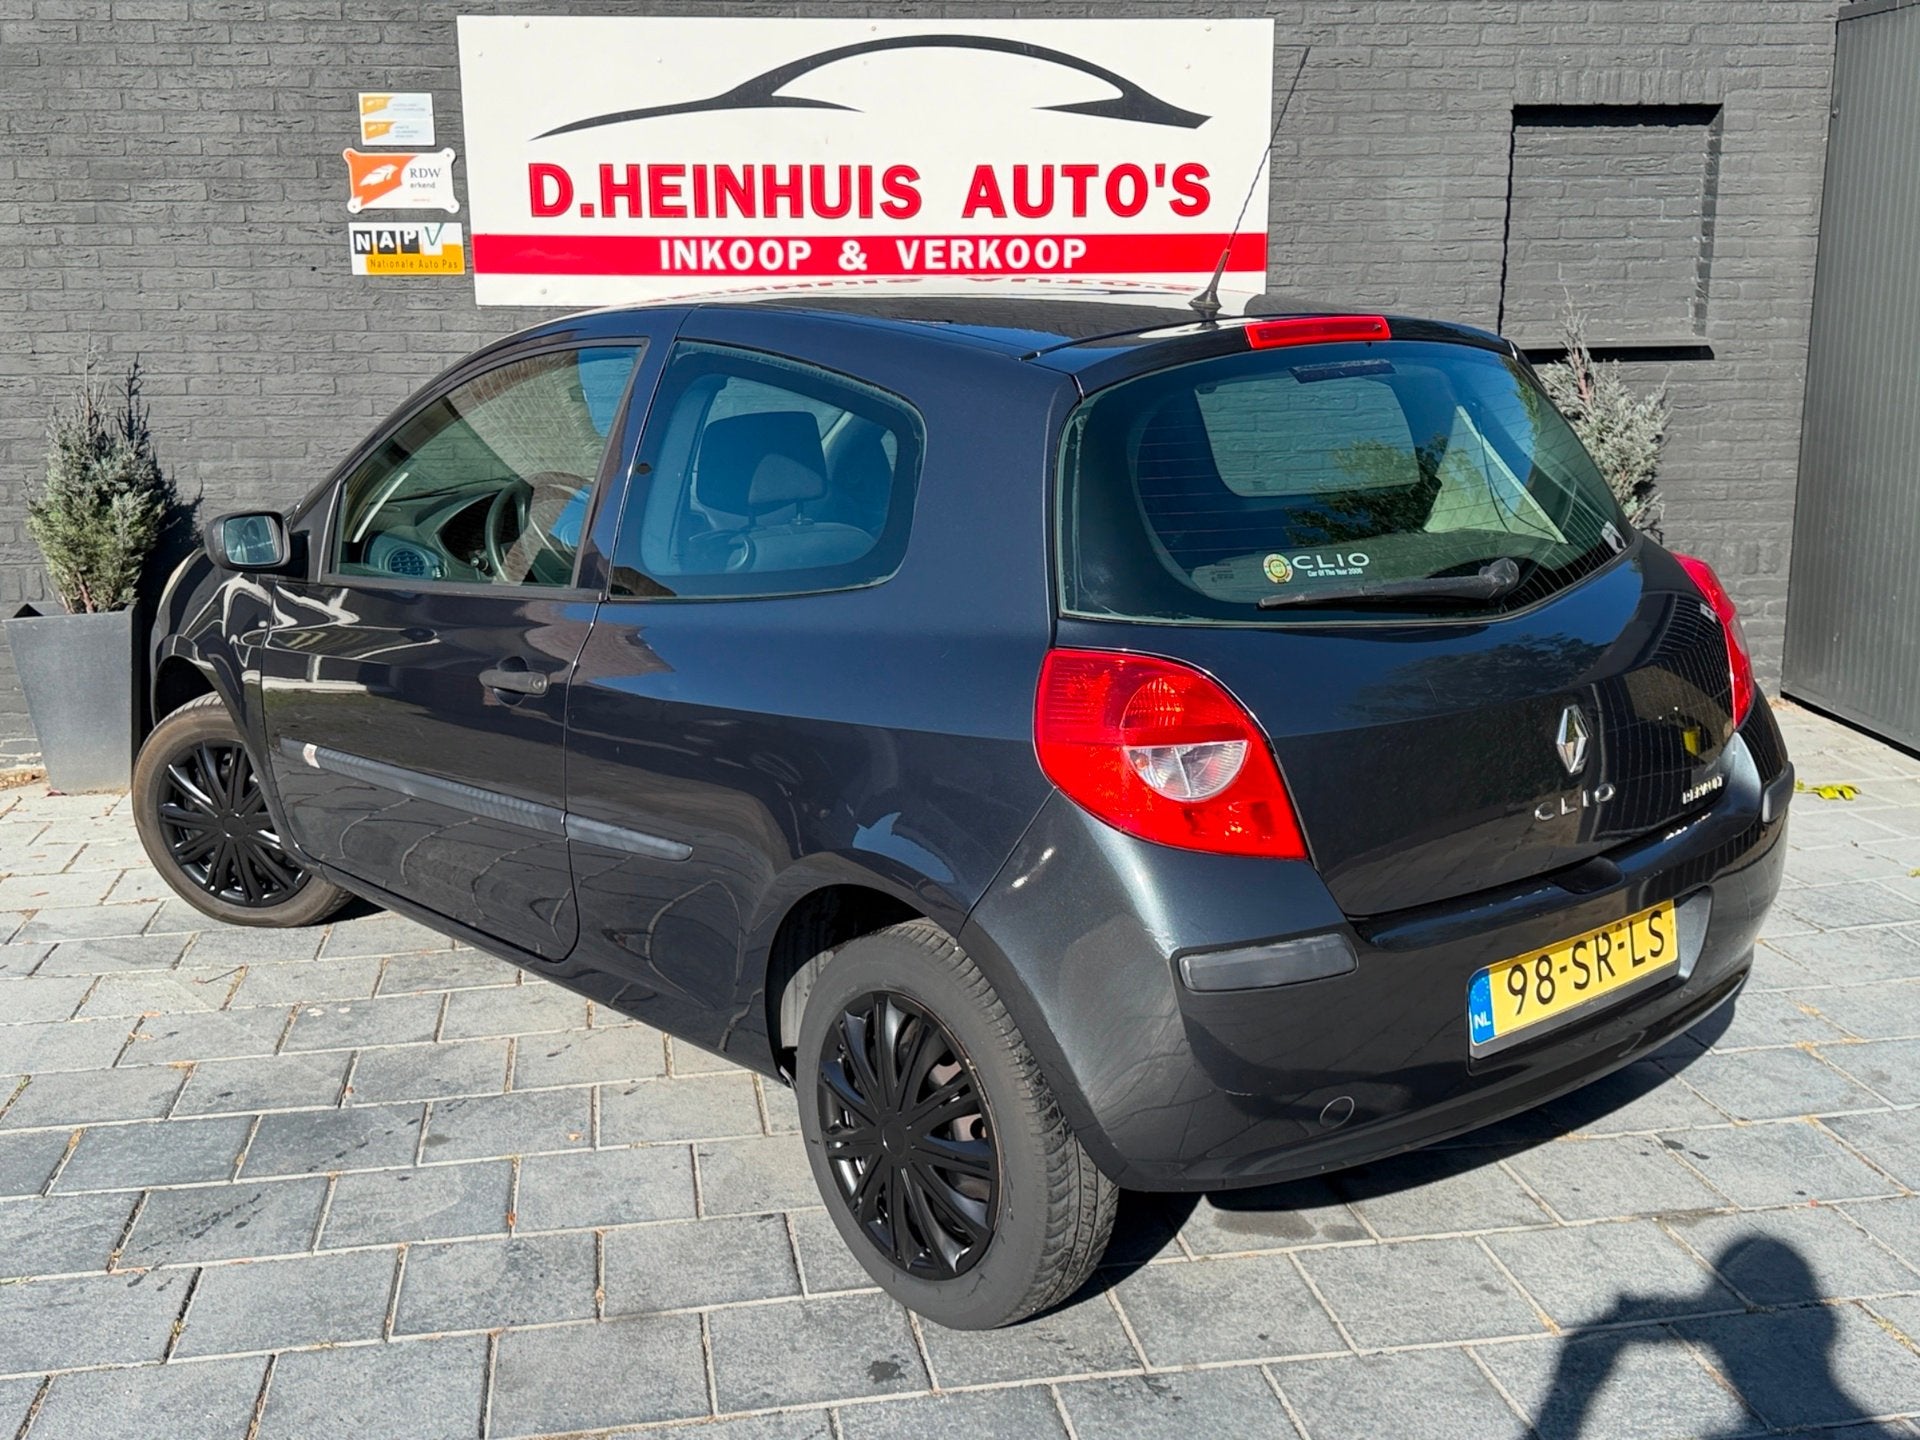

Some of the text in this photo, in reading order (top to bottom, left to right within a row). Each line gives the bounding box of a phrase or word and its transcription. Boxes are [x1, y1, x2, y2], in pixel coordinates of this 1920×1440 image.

[409, 167, 441, 178] RDW
[528, 163, 1211, 220] D.HEINHUIS AUTO'S
[370, 258, 458, 269] Nationale Auto Pas
[659, 238, 1087, 271] INKOOP & VERKOOP
[1292, 552, 1369, 570] CLIO
[1534, 783, 1616, 822] CLIO
[1506, 909, 1665, 1016] 98-SR-LS
[1473, 1010, 1492, 1030] NL
